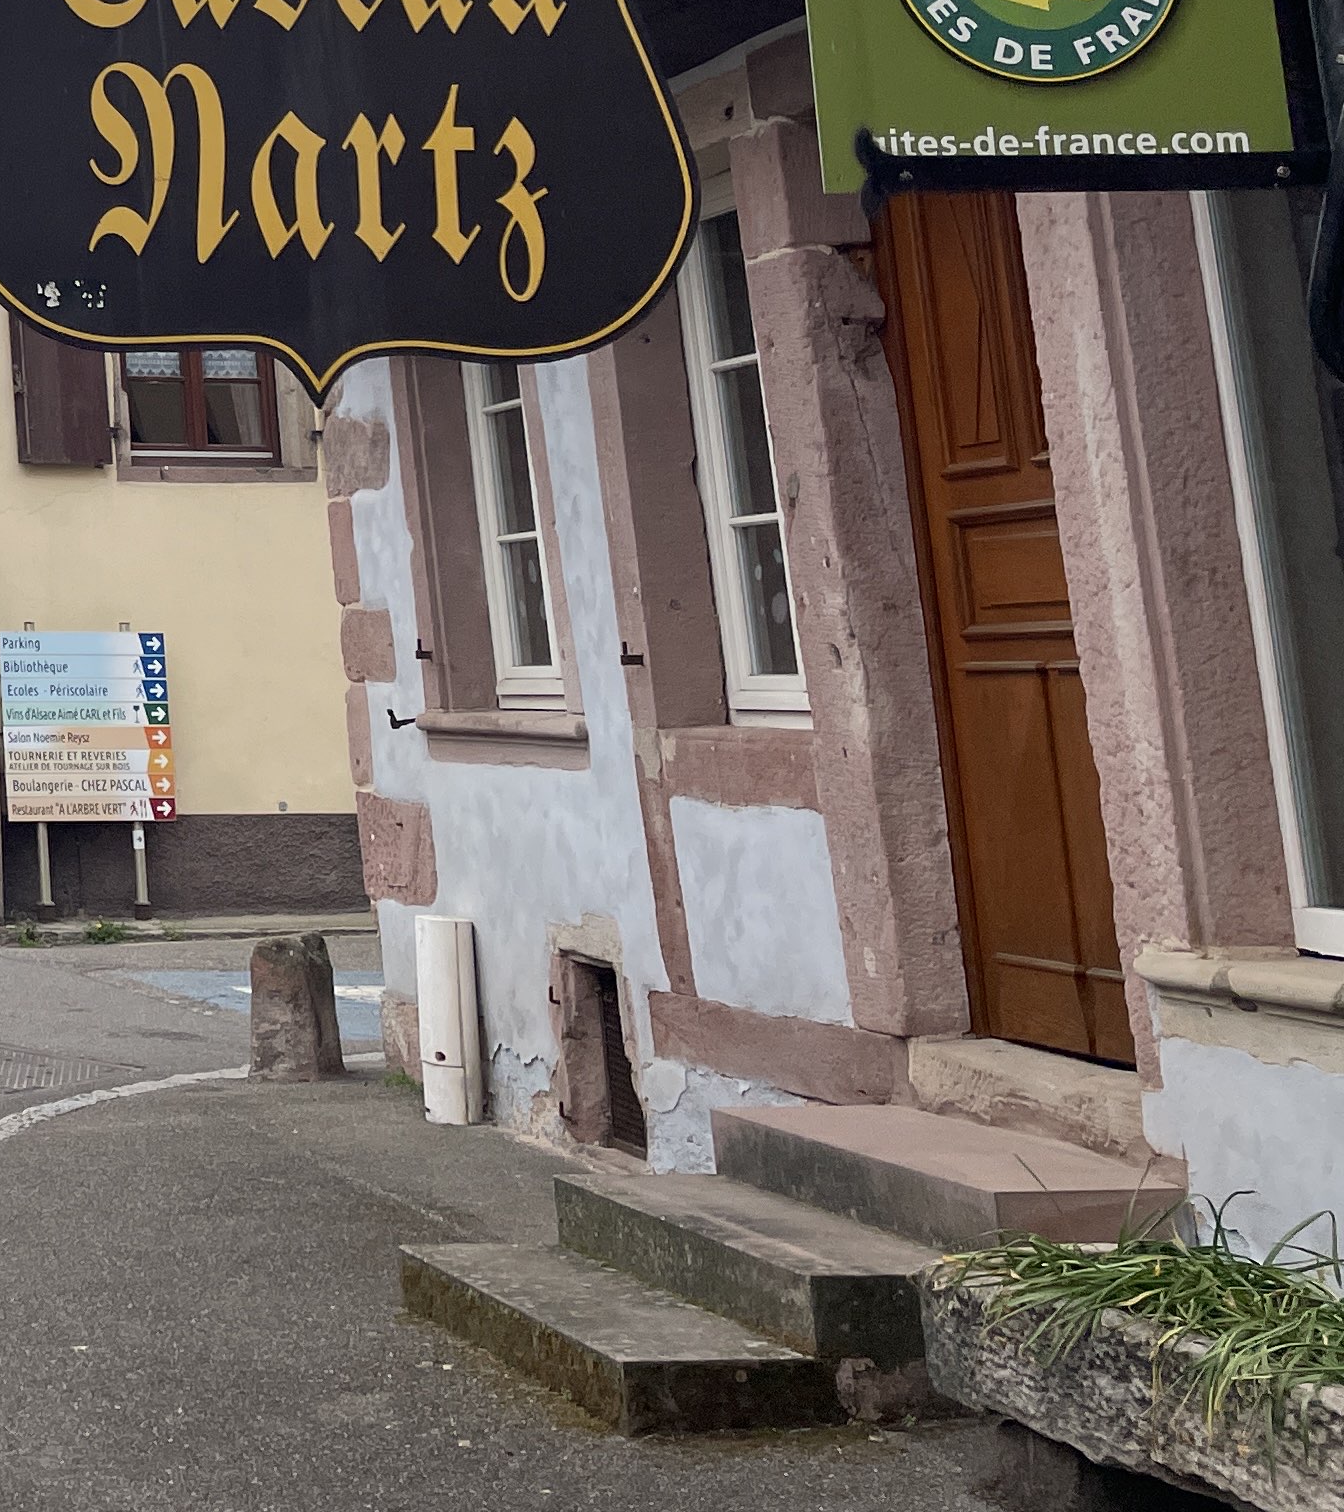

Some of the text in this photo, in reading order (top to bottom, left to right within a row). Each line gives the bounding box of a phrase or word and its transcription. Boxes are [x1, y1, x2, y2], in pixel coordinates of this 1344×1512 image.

[994, 37, 1054, 71] DE
[88, 61, 550, 302] Nartz
[2, 638, 41, 651] Parking
[3, 660, 69, 675] Bibliothèque
[7, 684, 39, 696] Ecoles
[49, 684, 109, 697] Périscolaire
[6, 706, 127, 721] Vins d'Alsace Aimé CARL et Fils
[7, 731, 32, 743] Salon
[67, 732, 90, 745] Reysz
[8, 751, 127, 761] TOURNERIE ET REVERIES
[9, 762, 131, 771] ATELIER DE TOURNAGE SUR BOIS
[13, 779, 74, 794] Boulangerie
[81, 779, 107, 792] CHEZ
[111, 779, 148, 792] PASCAL
[12, 804, 54, 816] Restaurant
[66, 802, 100, 816] L'ARBRE
